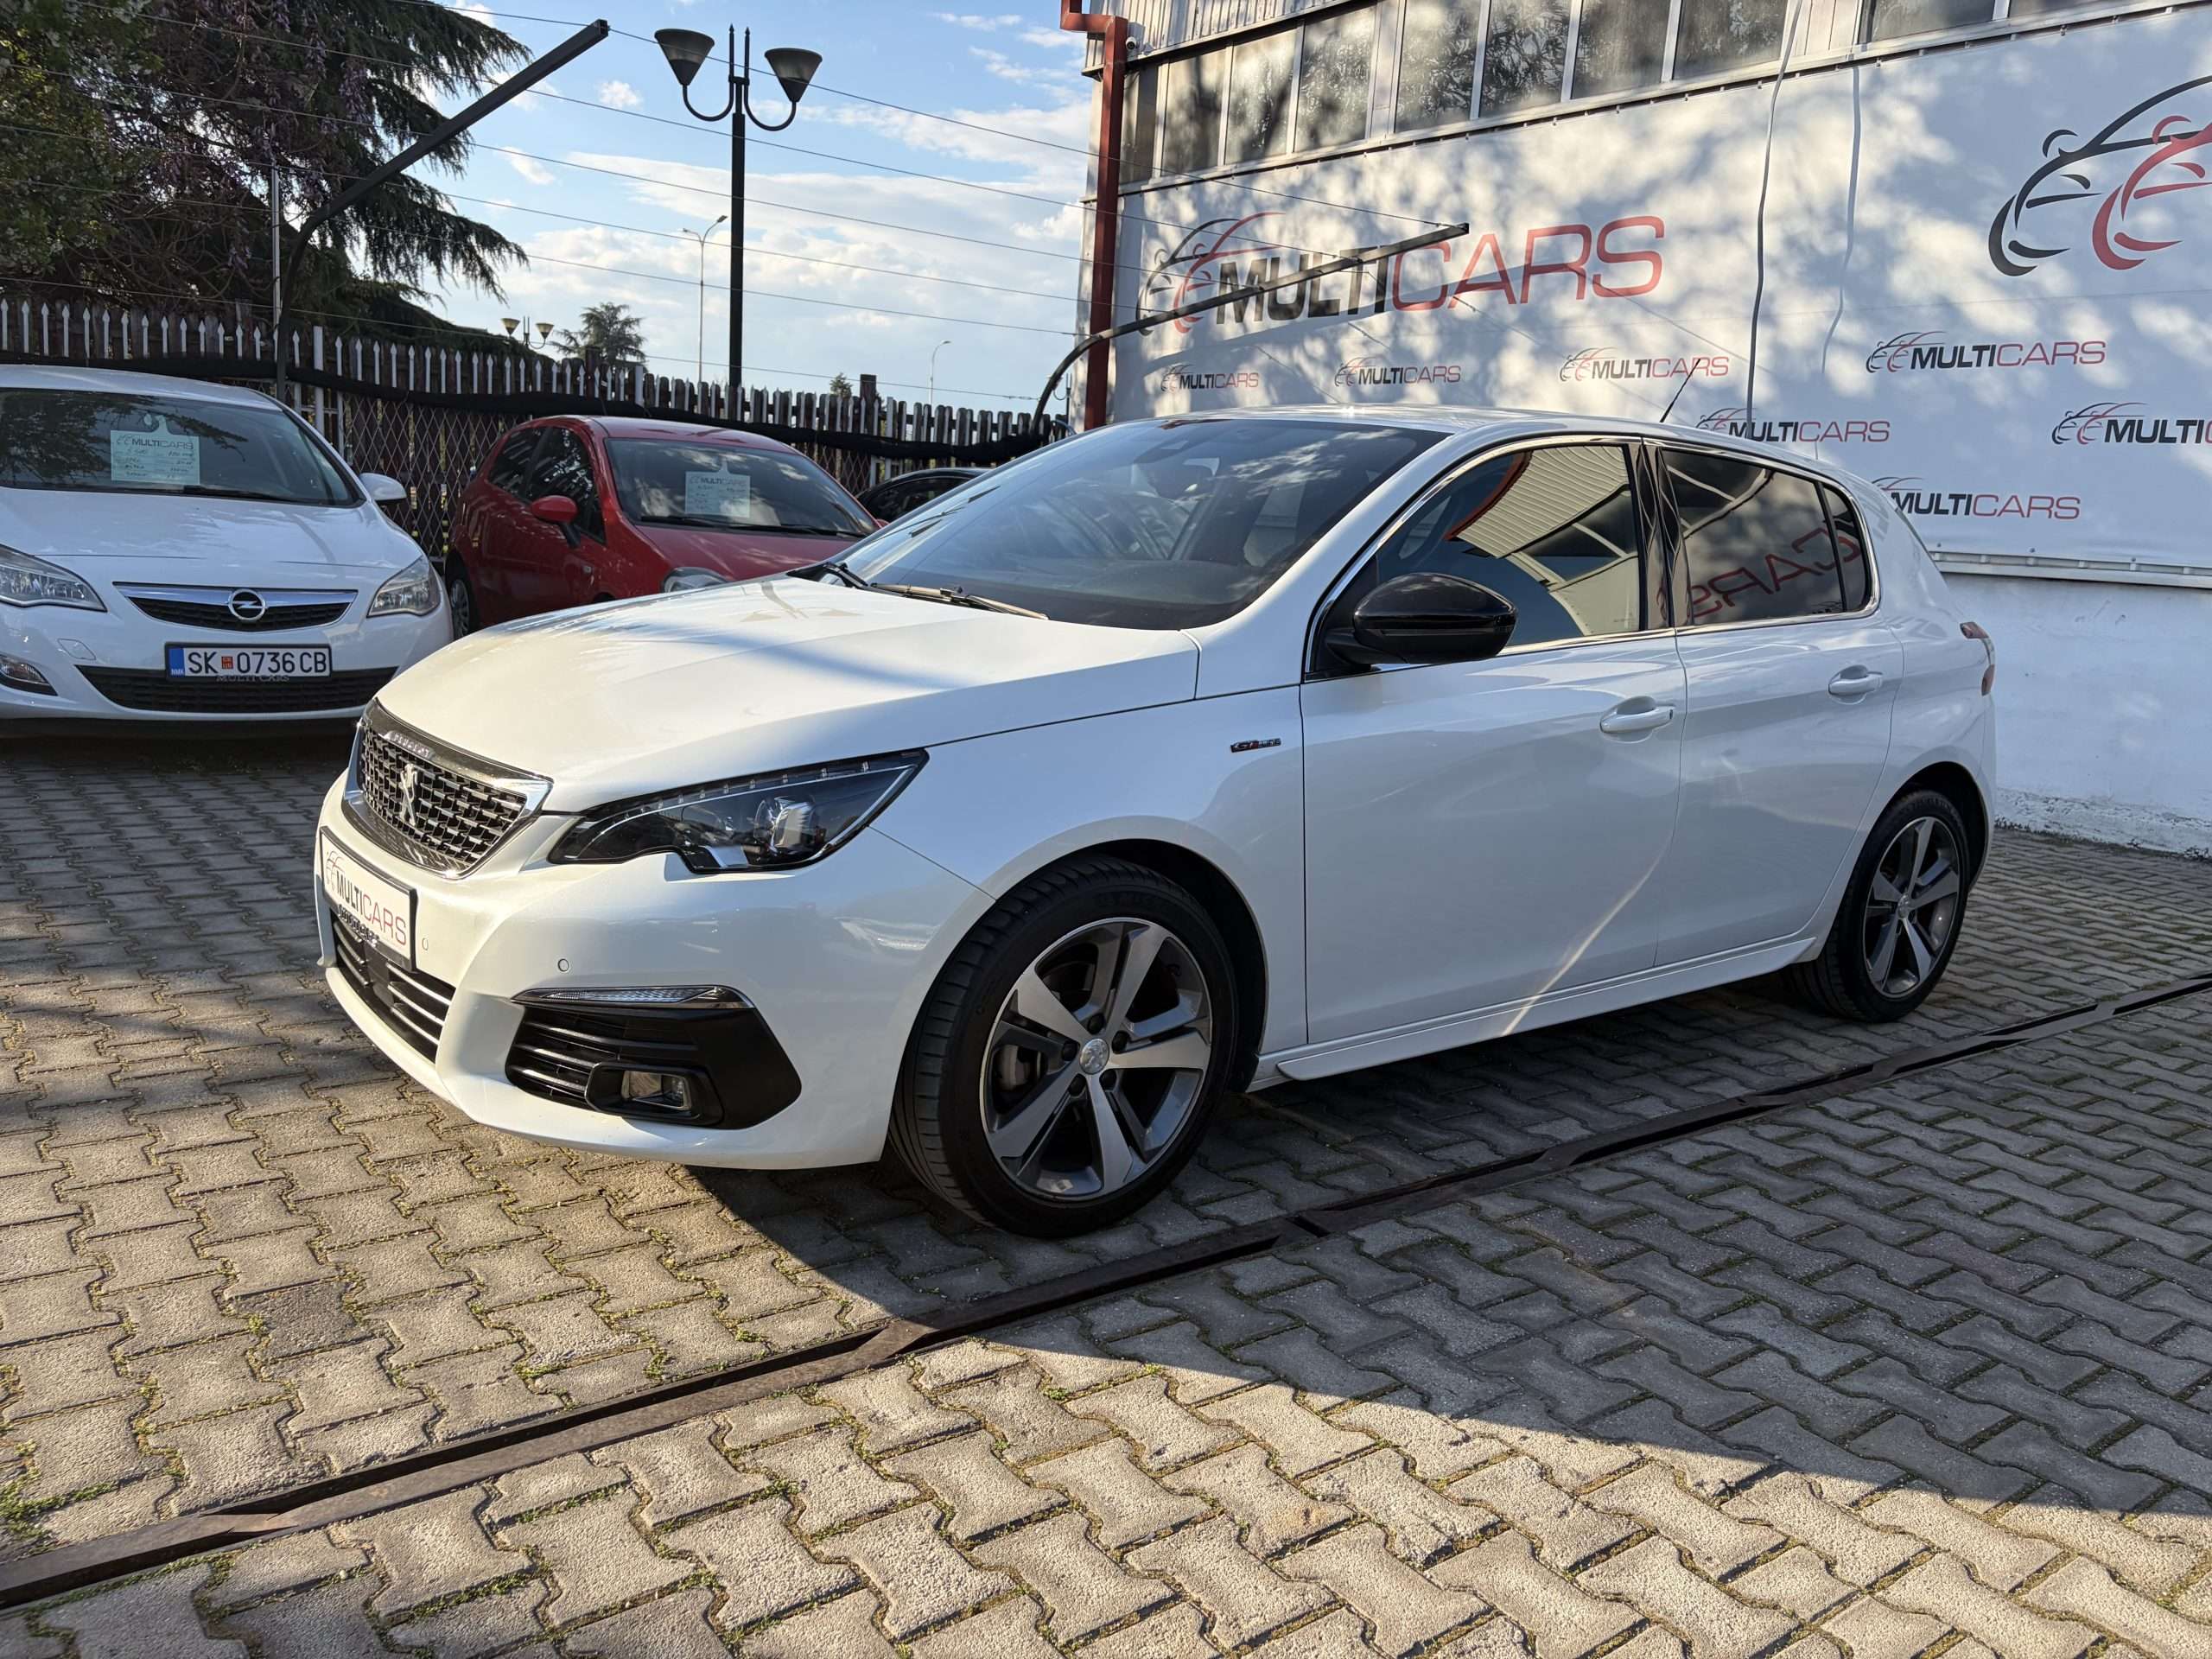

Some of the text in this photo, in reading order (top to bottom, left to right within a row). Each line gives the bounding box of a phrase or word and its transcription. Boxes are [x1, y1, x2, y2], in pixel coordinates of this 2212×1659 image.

[1217, 215, 1664, 324] MULTICARS
[1910, 341, 2106, 369] MULTICARS
[1358, 365, 1461, 385] MULTICARS
[1592, 356, 1728, 379] MULTICARS
[1179, 372, 1259, 390] MULTICARS
[1728, 421, 1890, 442] MULTICARS
[2104, 419, 2212, 444] MULTI
[132, 438, 194, 450] MULTICARS
[1891, 493, 2081, 520] MULTICARS
[188, 652, 327, 675] SK 0736 CB
[336, 870, 406, 946] MULTICARS
